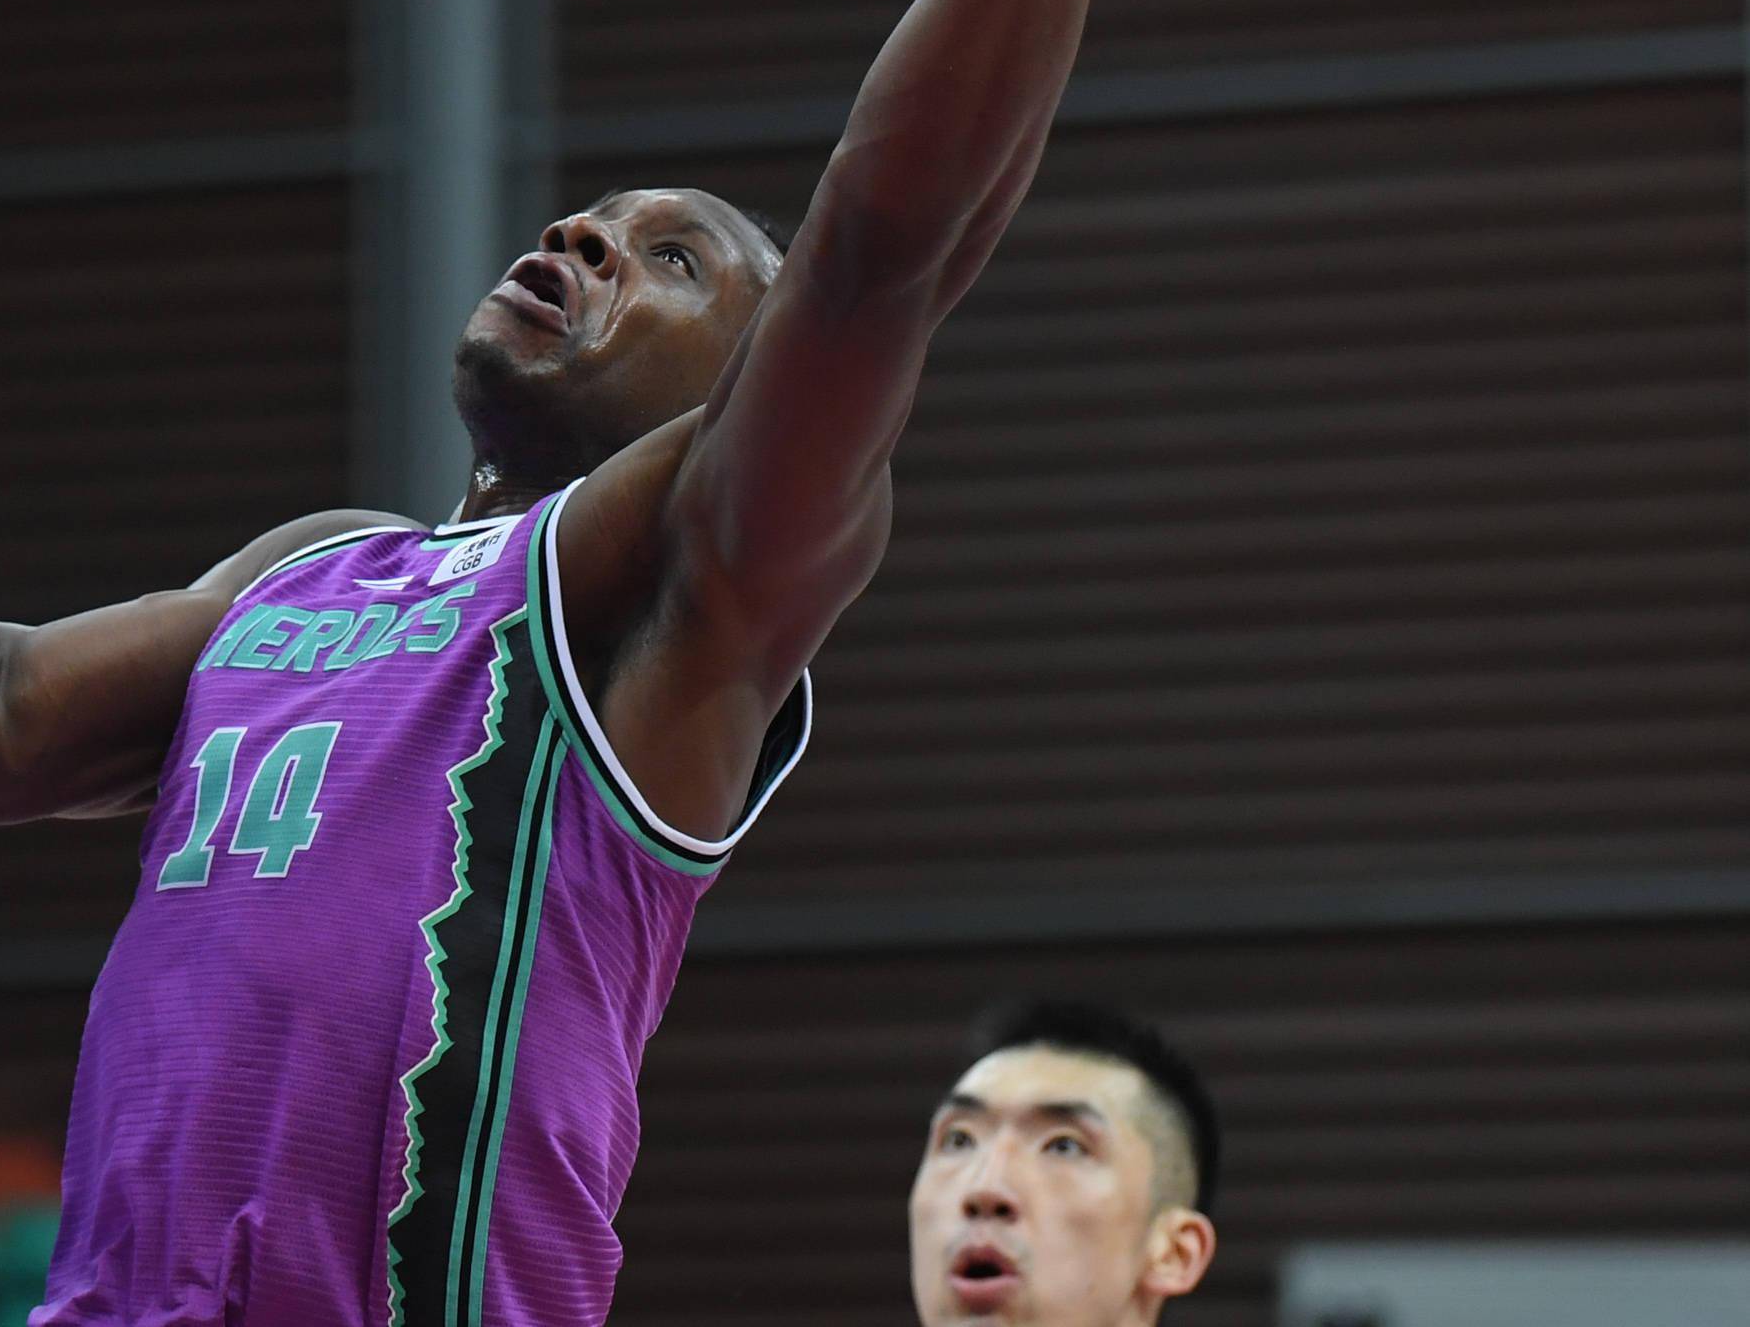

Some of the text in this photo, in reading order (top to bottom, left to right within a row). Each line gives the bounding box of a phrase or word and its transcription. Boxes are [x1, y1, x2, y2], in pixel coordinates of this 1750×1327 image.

[452, 551, 485, 574] CGB
[197, 581, 477, 673] HEROES
[155, 720, 343, 893] 14
